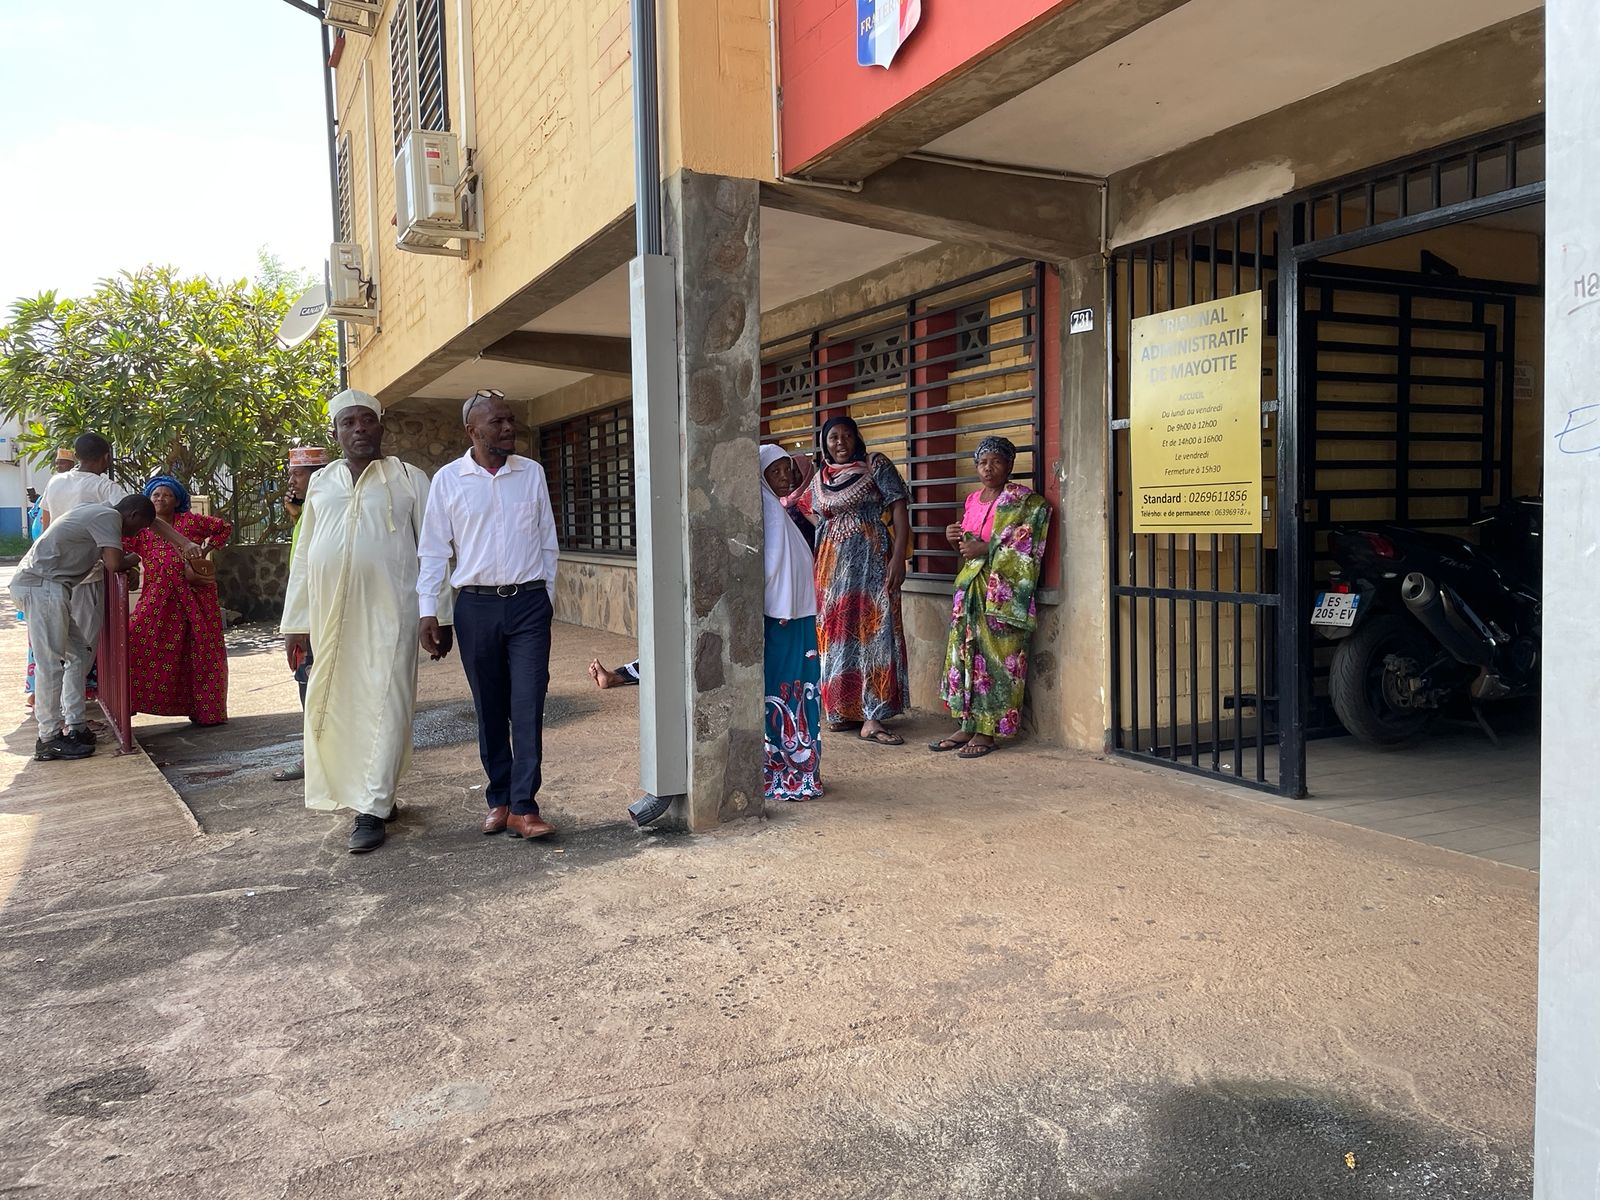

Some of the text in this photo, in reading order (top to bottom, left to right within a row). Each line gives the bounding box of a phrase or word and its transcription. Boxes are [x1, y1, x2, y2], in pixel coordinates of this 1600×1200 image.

[1073, 312, 1089, 328] 731
[1141, 327, 1249, 362] ADMINISTRATIF
[1150, 354, 1237, 384] DE MAYOTTE
[1178, 391, 1205, 401] ACCUEIL
[1161, 410, 1170, 418] Du
[1171, 408, 1185, 417] lundi
[1196, 403, 1223, 414] vendredi
[1167, 424, 1175, 432] De
[1176, 422, 1191, 431] 9h00
[1198, 419, 1218, 429] 12h00
[1162, 439, 1168, 447] Et
[1169, 438, 1177, 447] de
[1178, 437, 1197, 446] 14h00
[1203, 434, 1223, 444] 16h00
[1175, 450, 1209, 461] Le vendredi
[1165, 467, 1195, 476] Fermeture
[1201, 464, 1222, 474] 15h30
[1143, 492, 1181, 505] Standard
[1188, 490, 1248, 503] 0269611856
[1175, 509, 1210, 518] permanence
[1314, 608, 1354, 620] 205-EV
